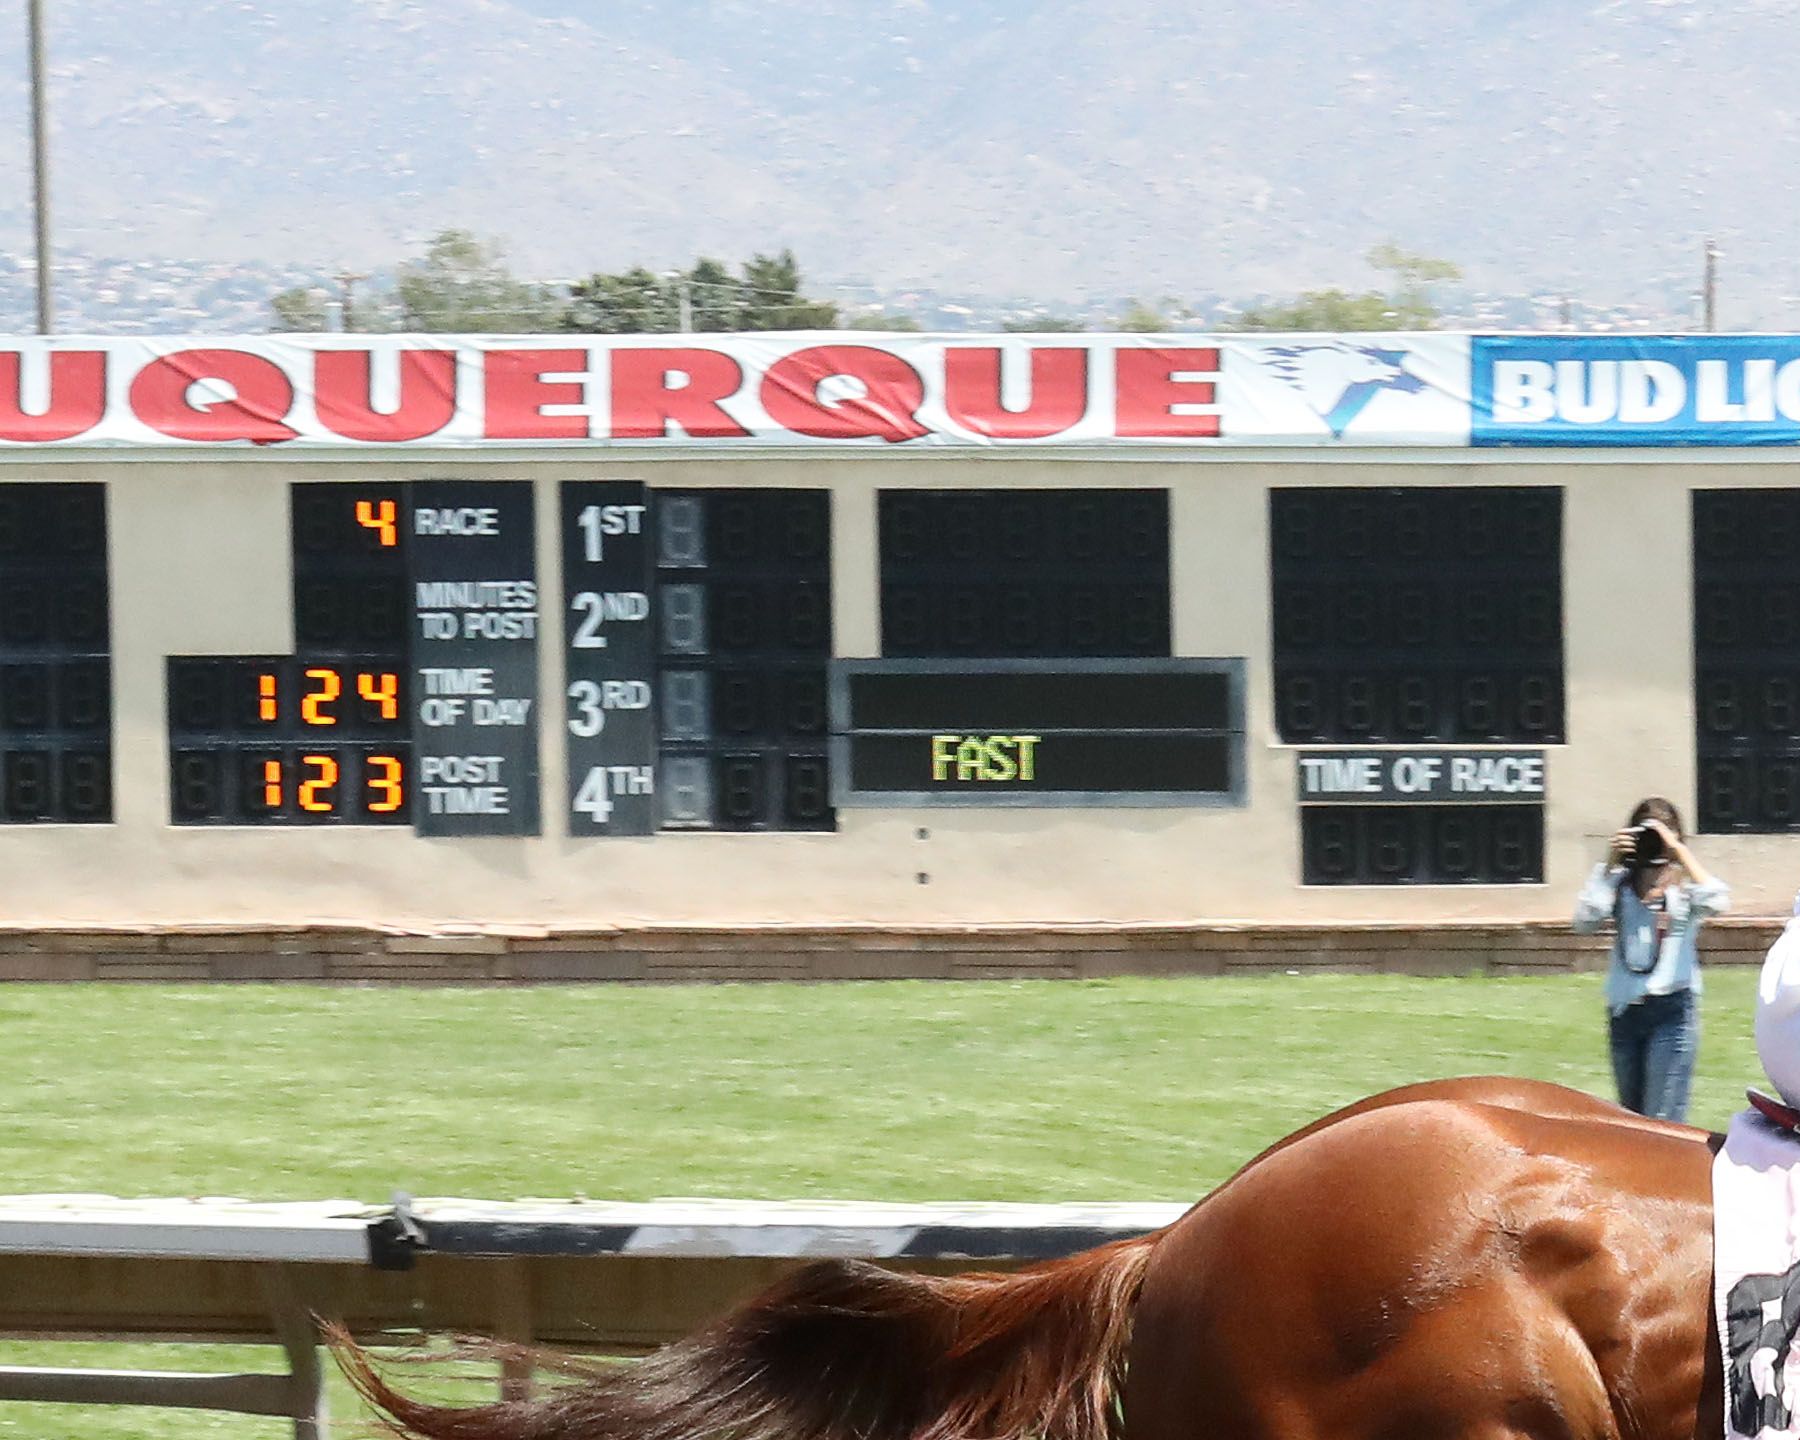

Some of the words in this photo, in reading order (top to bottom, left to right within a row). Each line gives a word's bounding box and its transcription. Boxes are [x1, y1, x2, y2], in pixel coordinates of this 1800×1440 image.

[1492, 359, 1687, 424] BUD
[355, 500, 397, 546] 4
[414, 507, 499, 536] RACE
[577, 504, 646, 563] 1ST
[415, 580, 537, 609] MINUTES
[416, 612, 458, 640] TO
[462, 611, 539, 640] POST
[571, 591, 650, 649] 2ND
[259, 669, 398, 725] 124
[418, 667, 495, 695] TIME
[419, 698, 466, 727] OF
[471, 698, 533, 726] DAY
[567, 679, 651, 738] 3RD
[420, 756, 505, 784] POST
[931, 735, 1042, 781] FAST
[1299, 757, 1383, 793] TIME
[1391, 756, 1443, 794] OF
[1450, 756, 1544, 793] RACE
[265, 755, 404, 812] 123
[421, 786, 511, 814] TIME
[572, 765, 654, 824] 4TH
